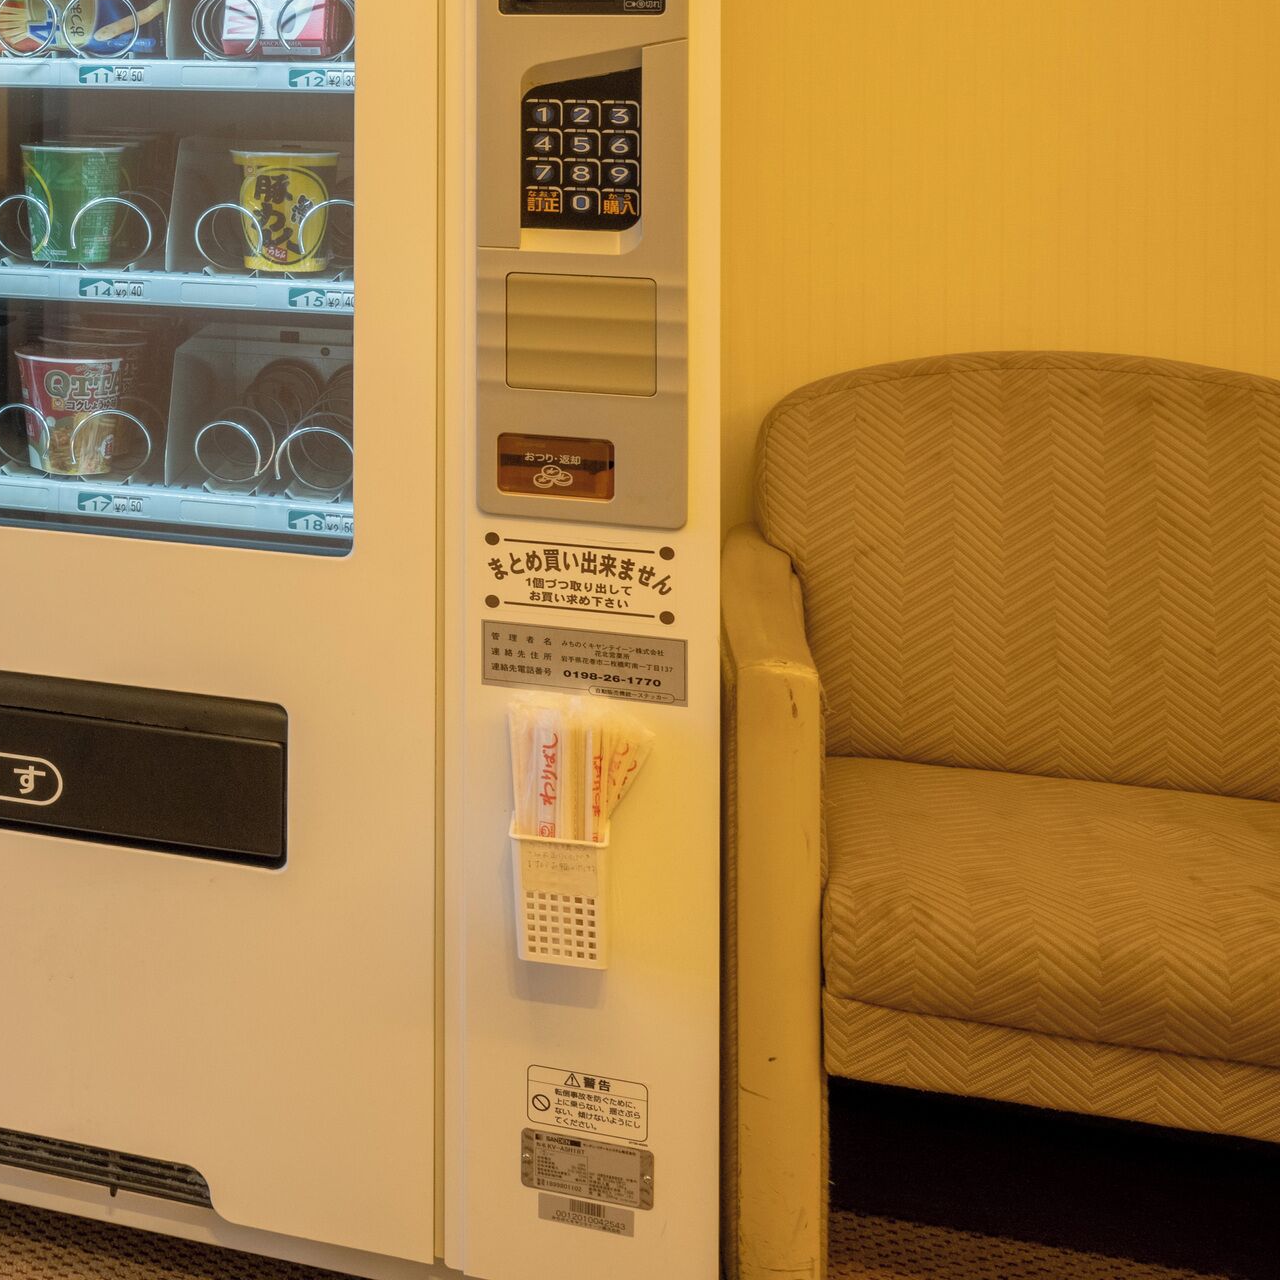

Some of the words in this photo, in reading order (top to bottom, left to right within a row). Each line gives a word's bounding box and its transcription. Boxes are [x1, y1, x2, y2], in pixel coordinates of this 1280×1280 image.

[92, 72, 110, 83] 11
[115, 69, 143, 82] ¥250
[303, 76, 324, 87] 12
[537, 107, 547, 122] 1
[573, 107, 590, 123] 2
[611, 108, 629, 124] 3
[534, 136, 552, 151] 4
[572, 137, 590, 152] 5
[611, 137, 629, 154] 6
[535, 165, 552, 181] 7
[572, 166, 590, 182] 8
[610, 167, 629, 182] 9
[527, 197, 560, 213] 訂正
[572, 195, 590, 211] 0
[603, 199, 637, 215] 購入
[93, 284, 112, 297] 14
[303, 294, 324, 307] 15
[523, 450, 582, 466] おつり・返却
[90, 499, 111, 512] 17
[302, 517, 324, 530] 18
[488, 548, 673, 596] まとめ買い出来ません
[525, 577, 632, 596] 1個づつ取り出して
[529, 591, 629, 609] お買い求め下さい
[491, 631, 552, 646] 管理者名
[491, 647, 552, 661] 連絡先住所
[491, 662, 552, 677] 連絡先電話番号
[562, 669, 662, 687] 0198-26-1770
[583, 1076, 611, 1092] 警告
[554, 1088, 637, 1109] 転倒事故を防ぐために、
